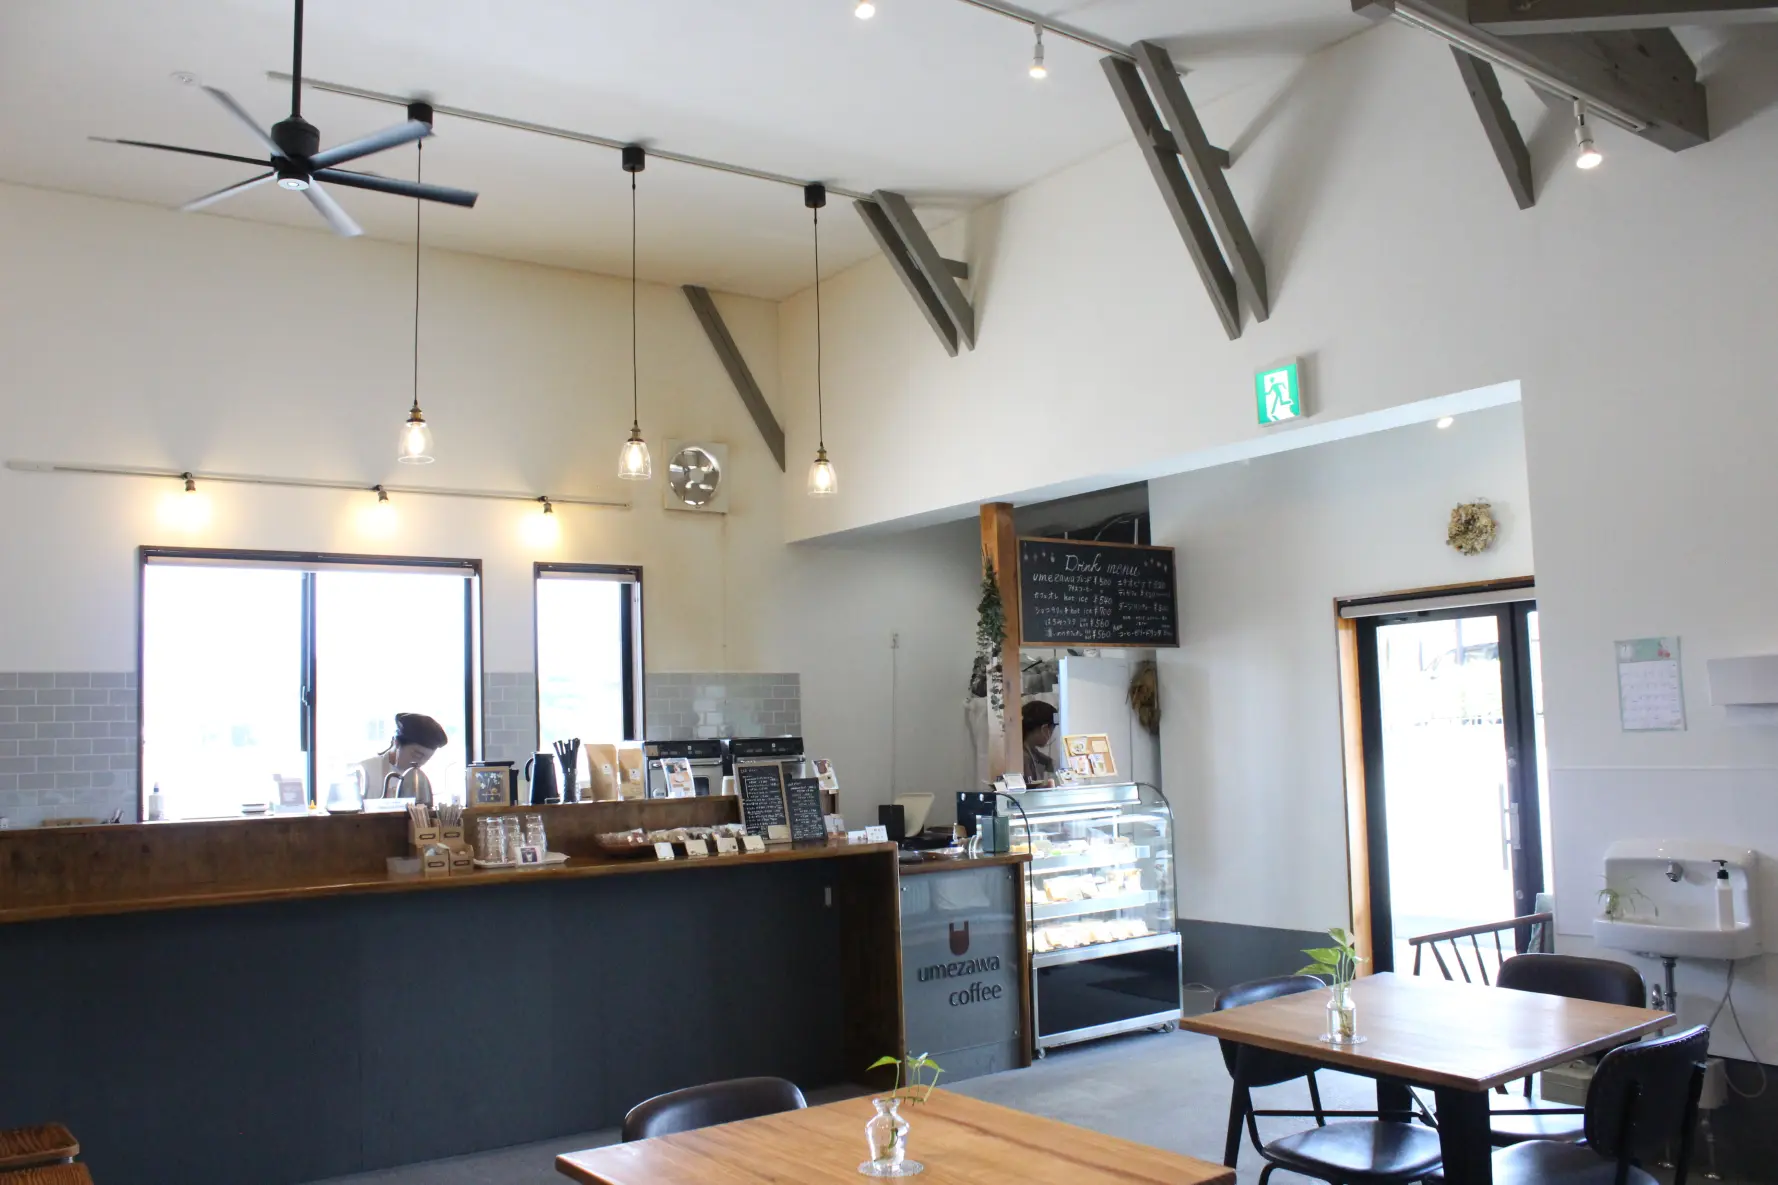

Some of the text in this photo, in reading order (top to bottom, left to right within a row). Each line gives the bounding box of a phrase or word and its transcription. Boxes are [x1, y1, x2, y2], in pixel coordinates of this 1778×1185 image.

[1065, 553, 1139, 577] Drink menu
[1034, 592, 1058, 600] カフェオレ
[1063, 592, 1075, 602] hot
[1078, 595, 1089, 603] ice
[917, 956, 1000, 982] umezawa
[948, 981, 1002, 1007] coffee
